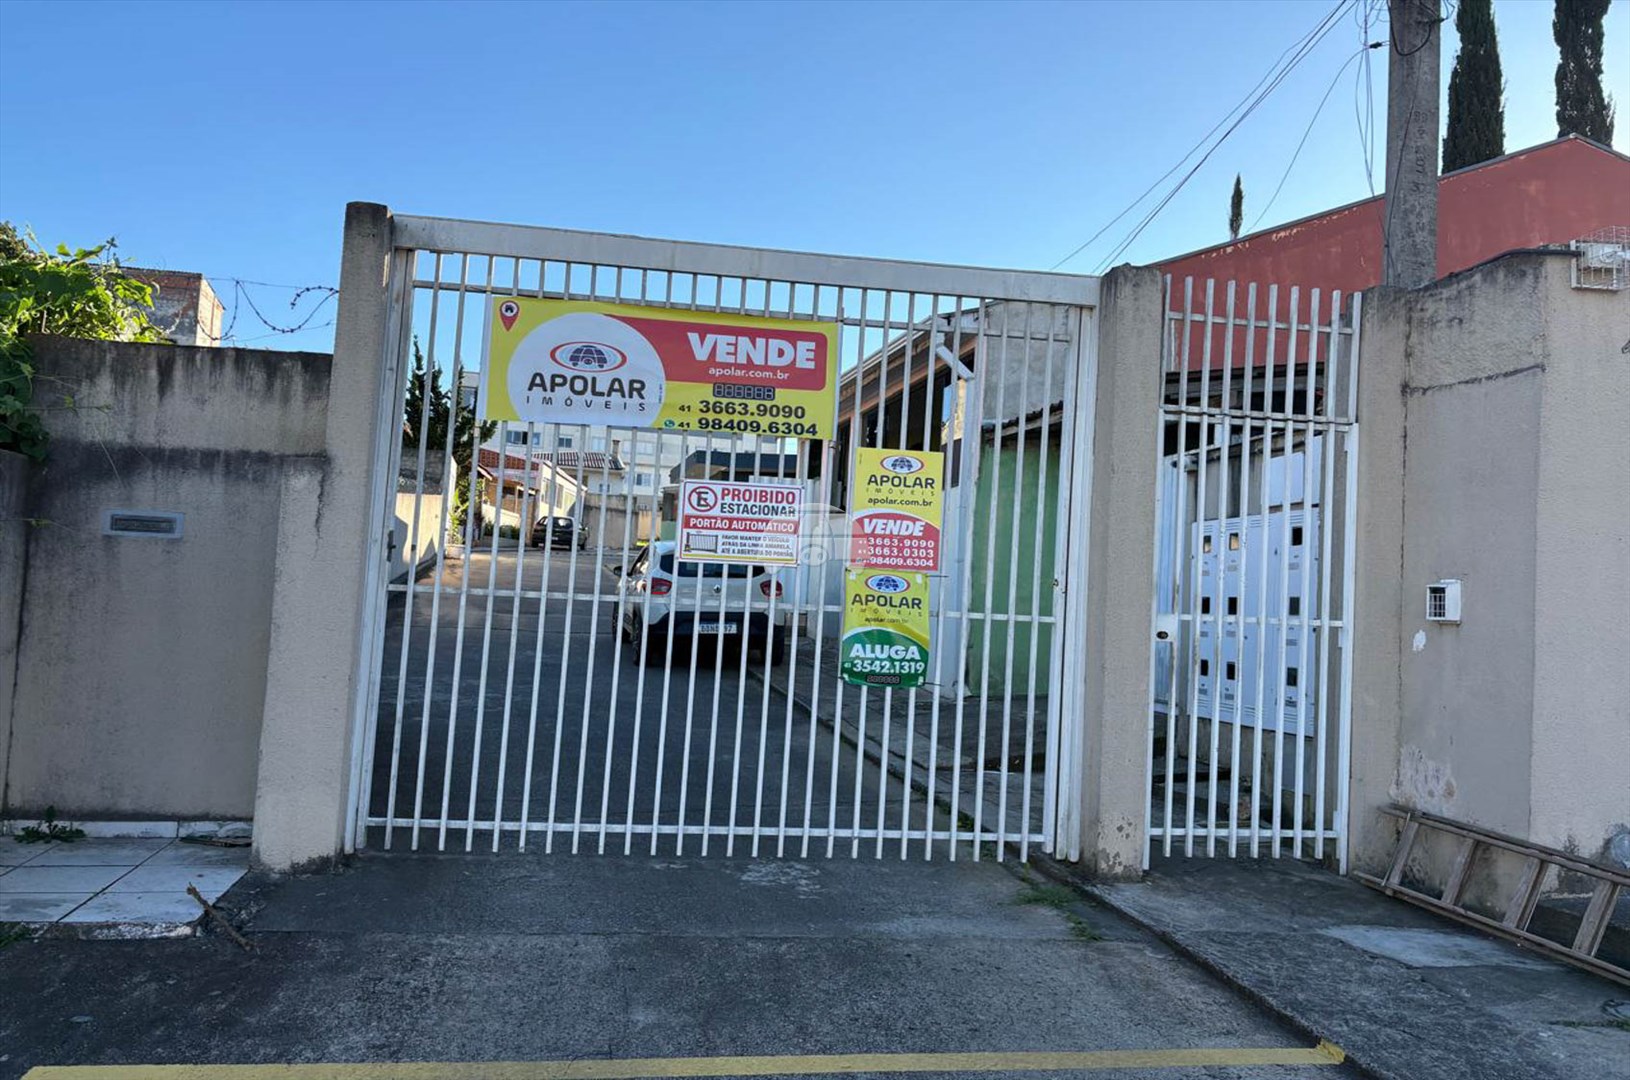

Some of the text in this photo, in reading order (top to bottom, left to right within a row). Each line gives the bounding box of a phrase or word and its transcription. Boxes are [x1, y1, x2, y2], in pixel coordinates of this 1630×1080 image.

[687, 332, 816, 369] VENDE
[708, 365, 790, 380] apolar.com.br
[527, 372, 646, 399] APOLAR
[526, 396, 646, 411] IMÓVEIS
[678, 400, 806, 419] 41 3663.9090
[677, 418, 818, 436] 41 98409.6304
[867, 474, 935, 489] APOLAR
[721, 487, 796, 505] PROIBIDO
[867, 496, 933, 507] apolar.com.br
[720, 502, 796, 517] ESTACIONAR
[689, 517, 795, 532] PORTÃO AUTOMÁTICO
[863, 518, 926, 537] VENDE
[867, 537, 935, 548] 3663.9090
[851, 593, 922, 609] APOLAR
[849, 643, 921, 660] ALUGA
[853, 660, 925, 674] 3542.1319
